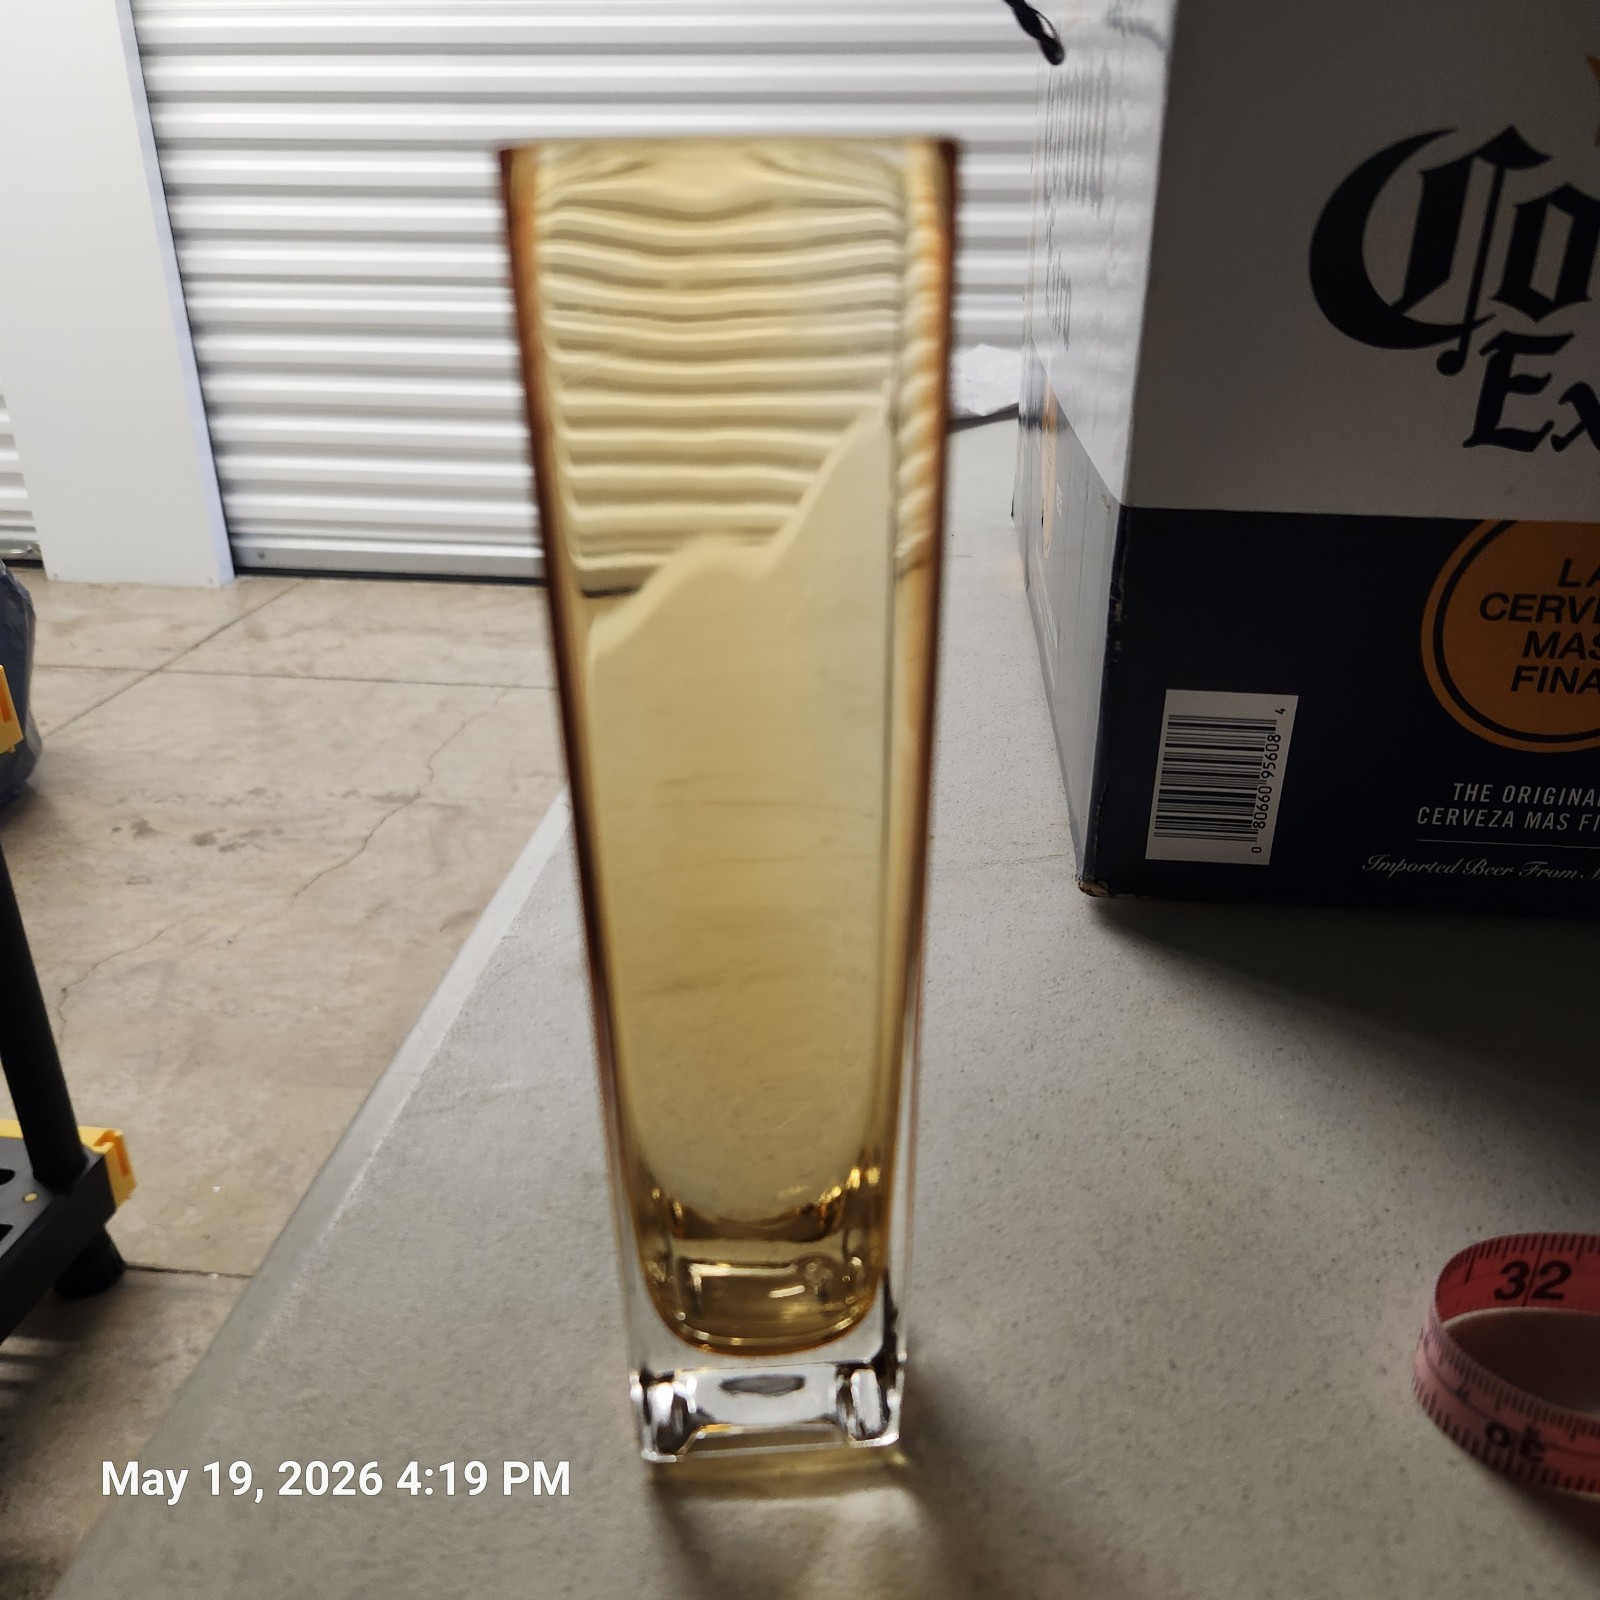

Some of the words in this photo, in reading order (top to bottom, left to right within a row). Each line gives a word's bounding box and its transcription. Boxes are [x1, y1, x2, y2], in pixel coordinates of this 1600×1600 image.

[1479, 592, 1600, 624] CERV
[1510, 665, 1600, 694] FINA
[1261, 734, 1281, 779] 95608
[1252, 785, 1272, 829] 80660
[1452, 782, 1493, 802] THE
[1502, 785, 1600, 807] ORIGINA
[1416, 806, 1514, 829] CERVEZA
[1523, 811, 1570, 832] MAS
[1251, 846, 1262, 854] 0
[1362, 854, 1464, 878] Imported
[1462, 858, 1514, 877] Beer
[1518, 861, 1578, 880] From
[1493, 1260, 1573, 1301] 32
